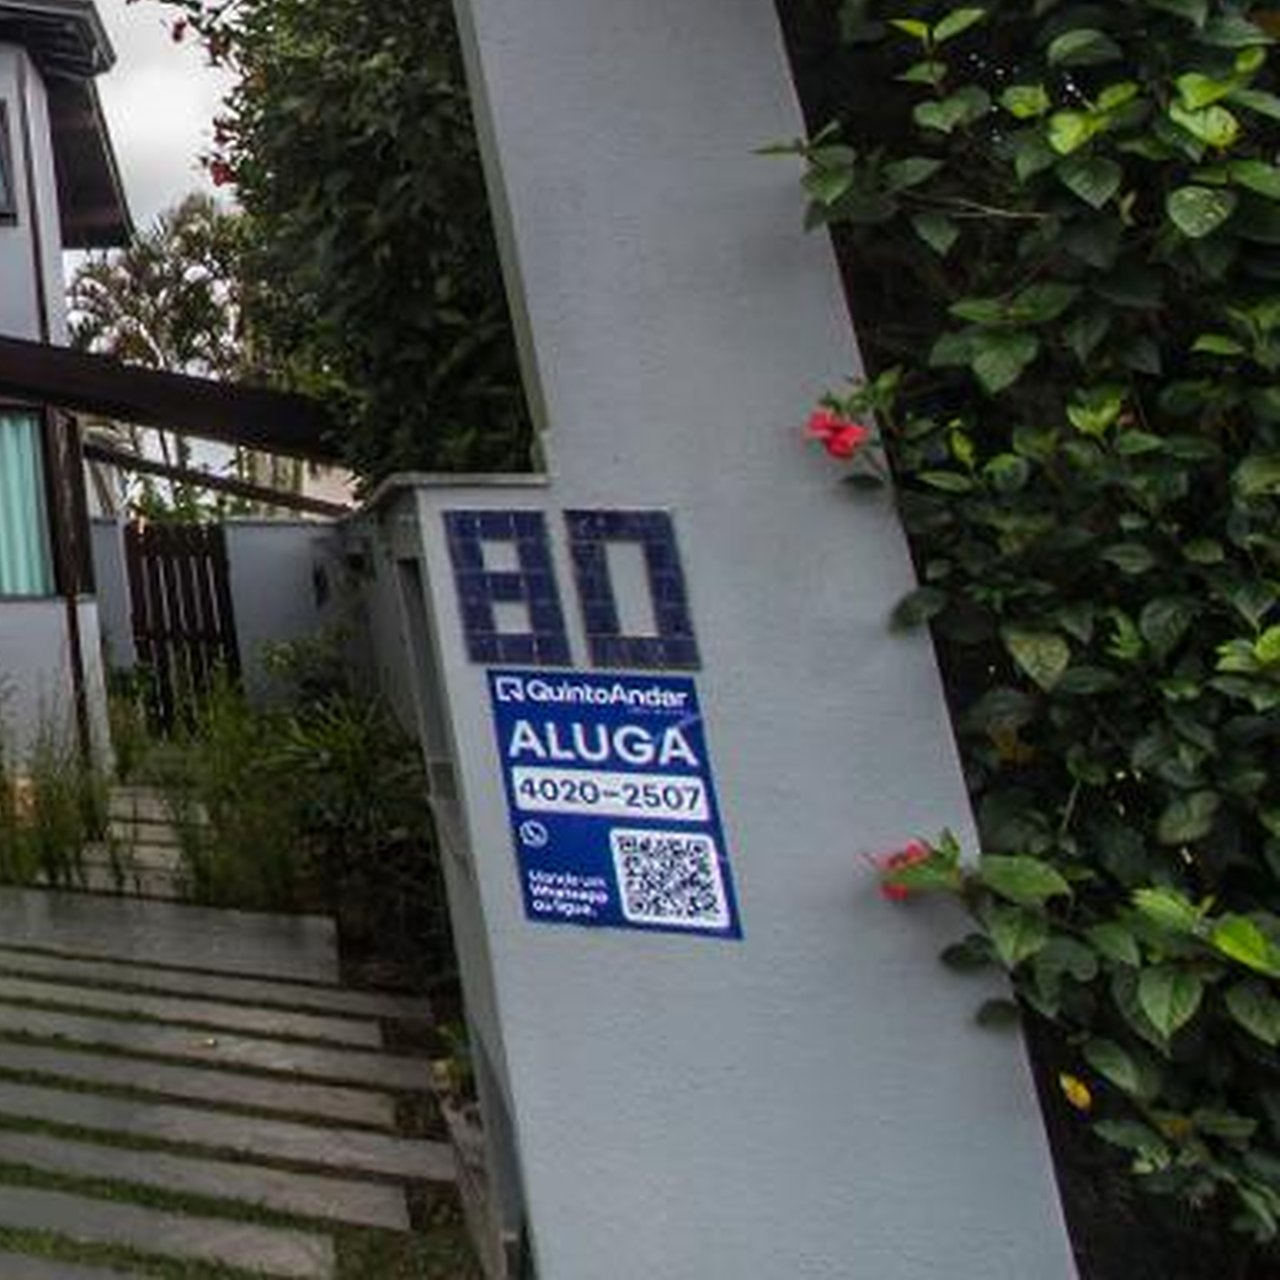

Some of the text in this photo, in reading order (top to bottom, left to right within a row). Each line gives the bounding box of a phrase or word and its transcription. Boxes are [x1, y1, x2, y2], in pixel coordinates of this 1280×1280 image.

[442, 508, 702, 671] 80
[526, 678, 688, 708] QuintoAndar
[508, 719, 700, 767] ALUGA
[519, 777, 701, 811] 4020-2507
